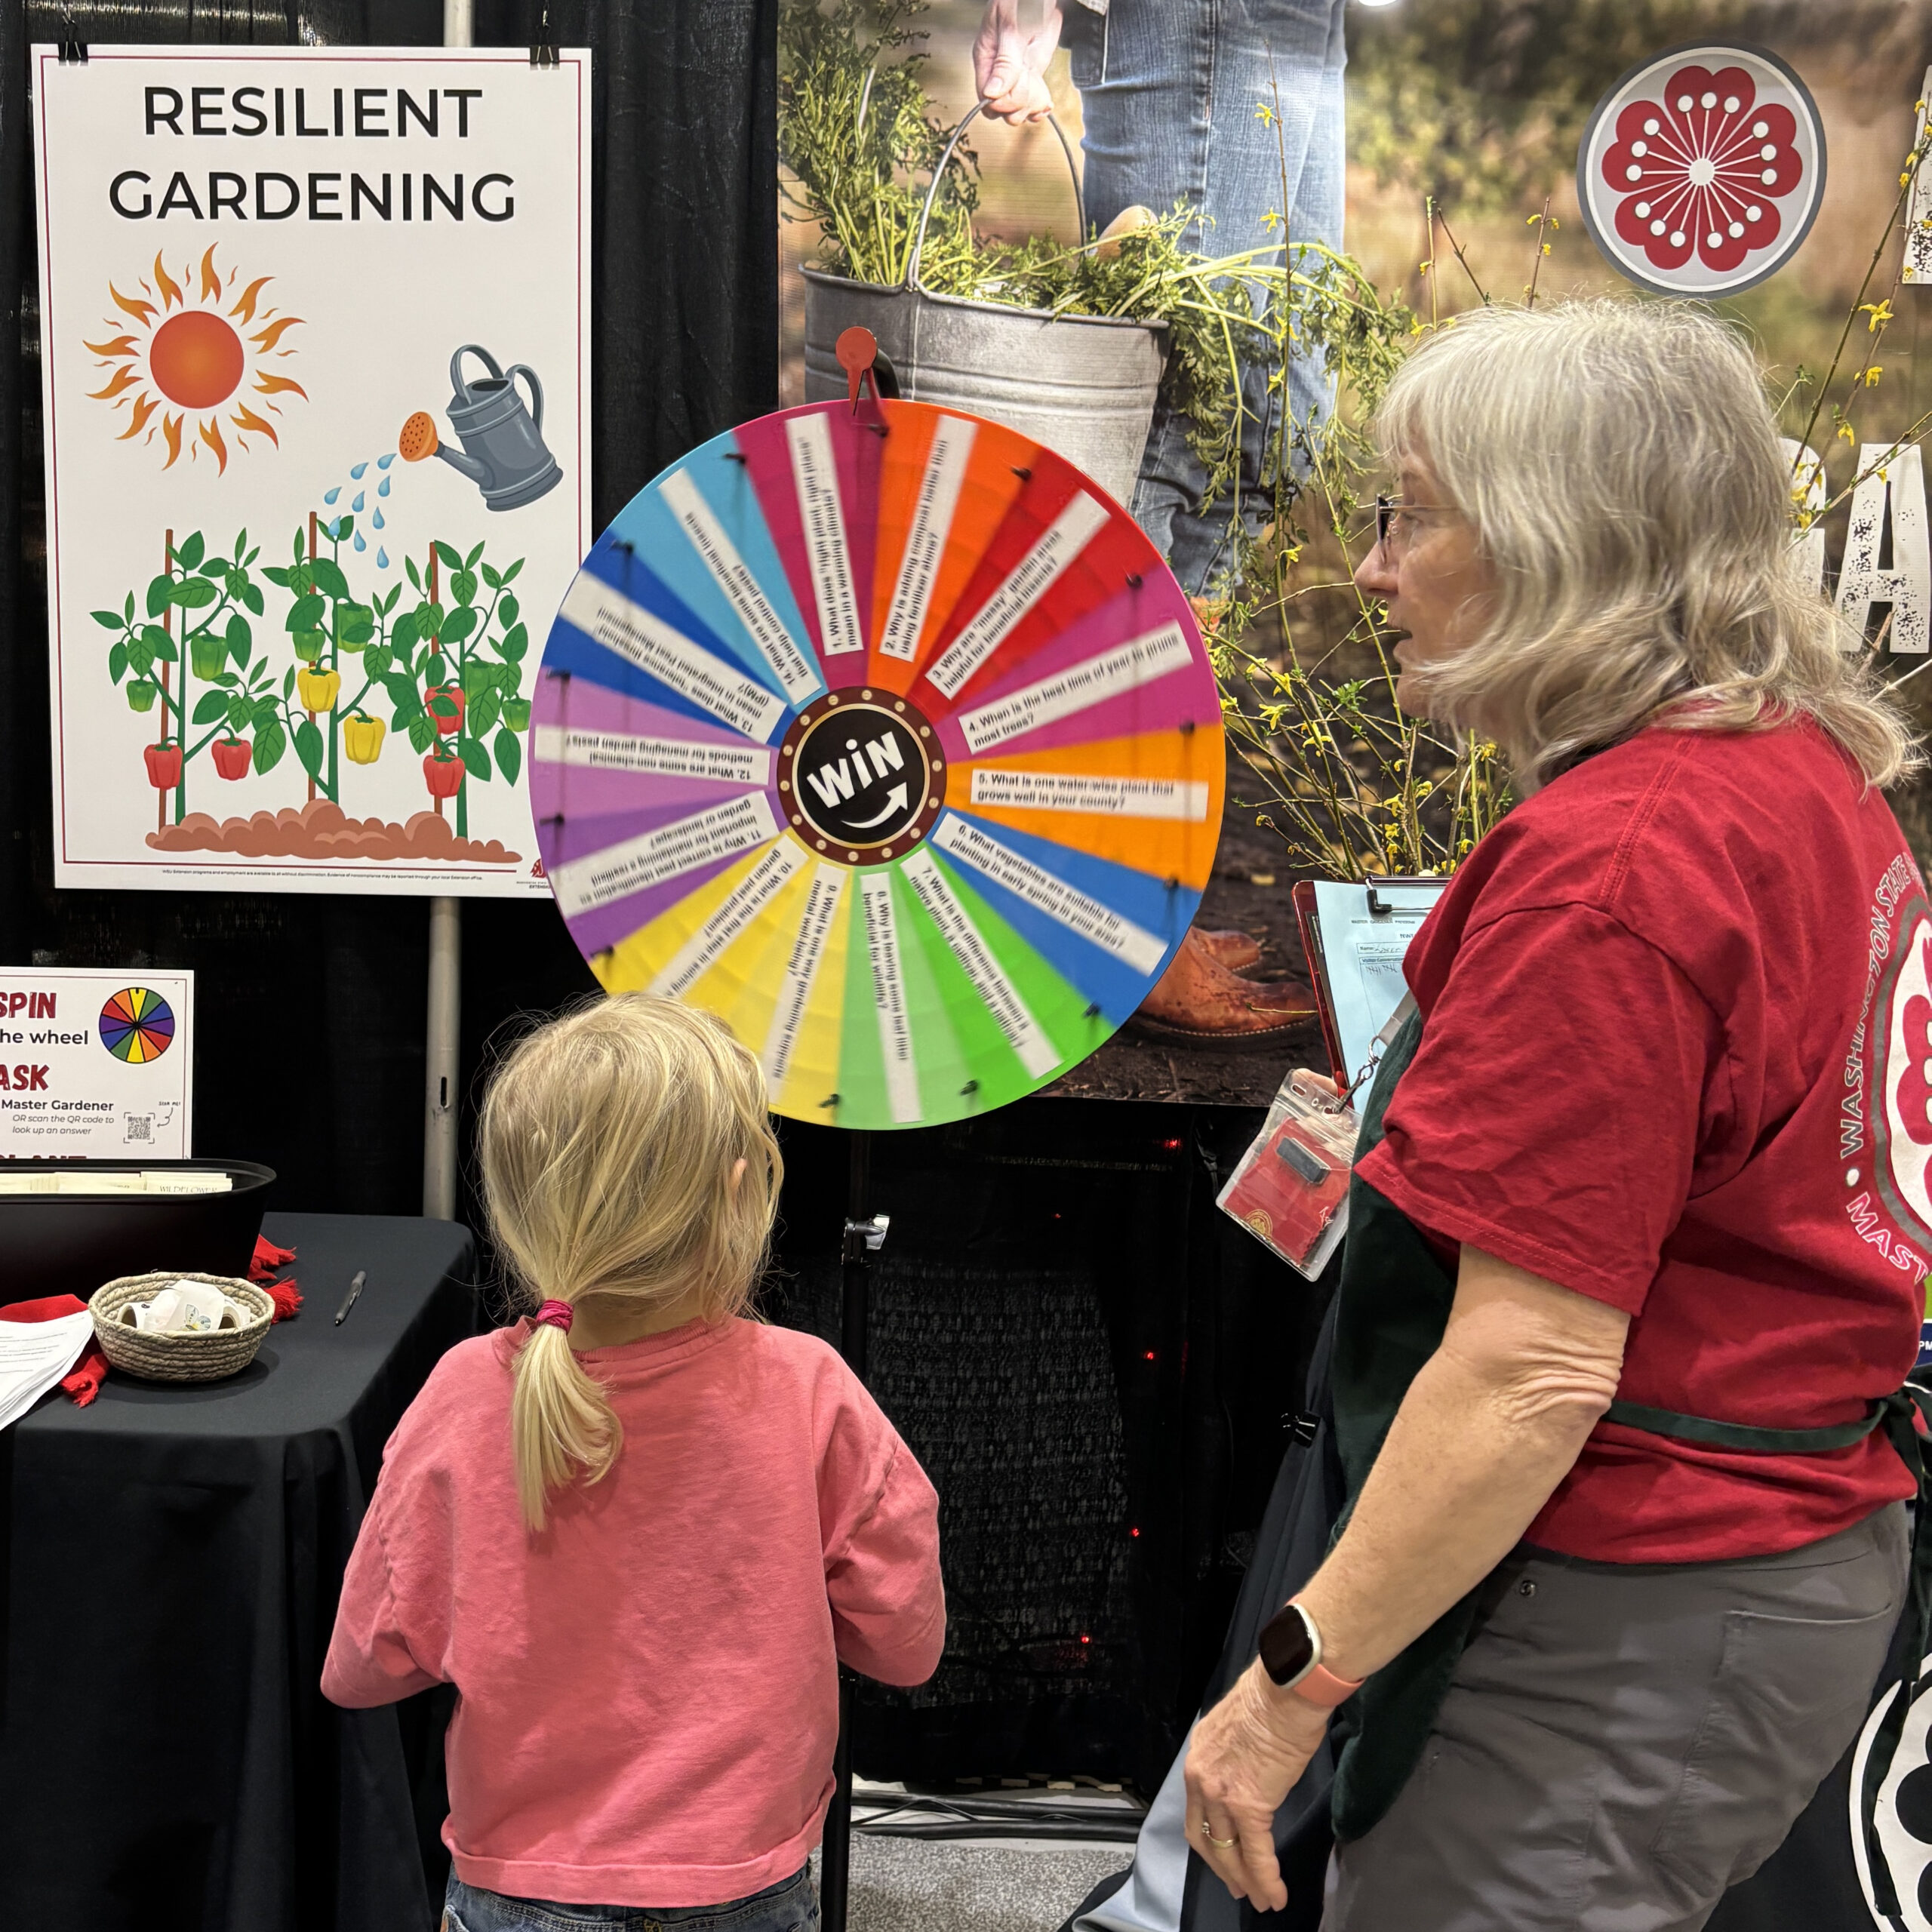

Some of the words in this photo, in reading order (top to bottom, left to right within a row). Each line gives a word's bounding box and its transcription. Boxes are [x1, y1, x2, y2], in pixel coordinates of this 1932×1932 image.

[144, 86, 483, 138] RESILIENT
[109, 170, 515, 222] GARDENING
[826, 607, 840, 635] What
[888, 611, 904, 637] Why
[940, 646, 963, 672] Why
[713, 701, 739, 722] What
[979, 706, 1011, 728] When
[974, 728, 1001, 747] most
[708, 766, 733, 778] What
[992, 773, 1018, 786] What
[968, 830, 995, 853] What
[757, 874, 783, 897] What
[1875, 852, 1910, 916] STATE
[0, 992, 57, 1019] SPIN
[29, 1029, 88, 1045] wheel
[0, 1064, 50, 1091] ASK
[2, 1099, 48, 1110] Master
[51, 1100, 114, 1111] Gardener
[67, 1115, 81, 1124] QR
